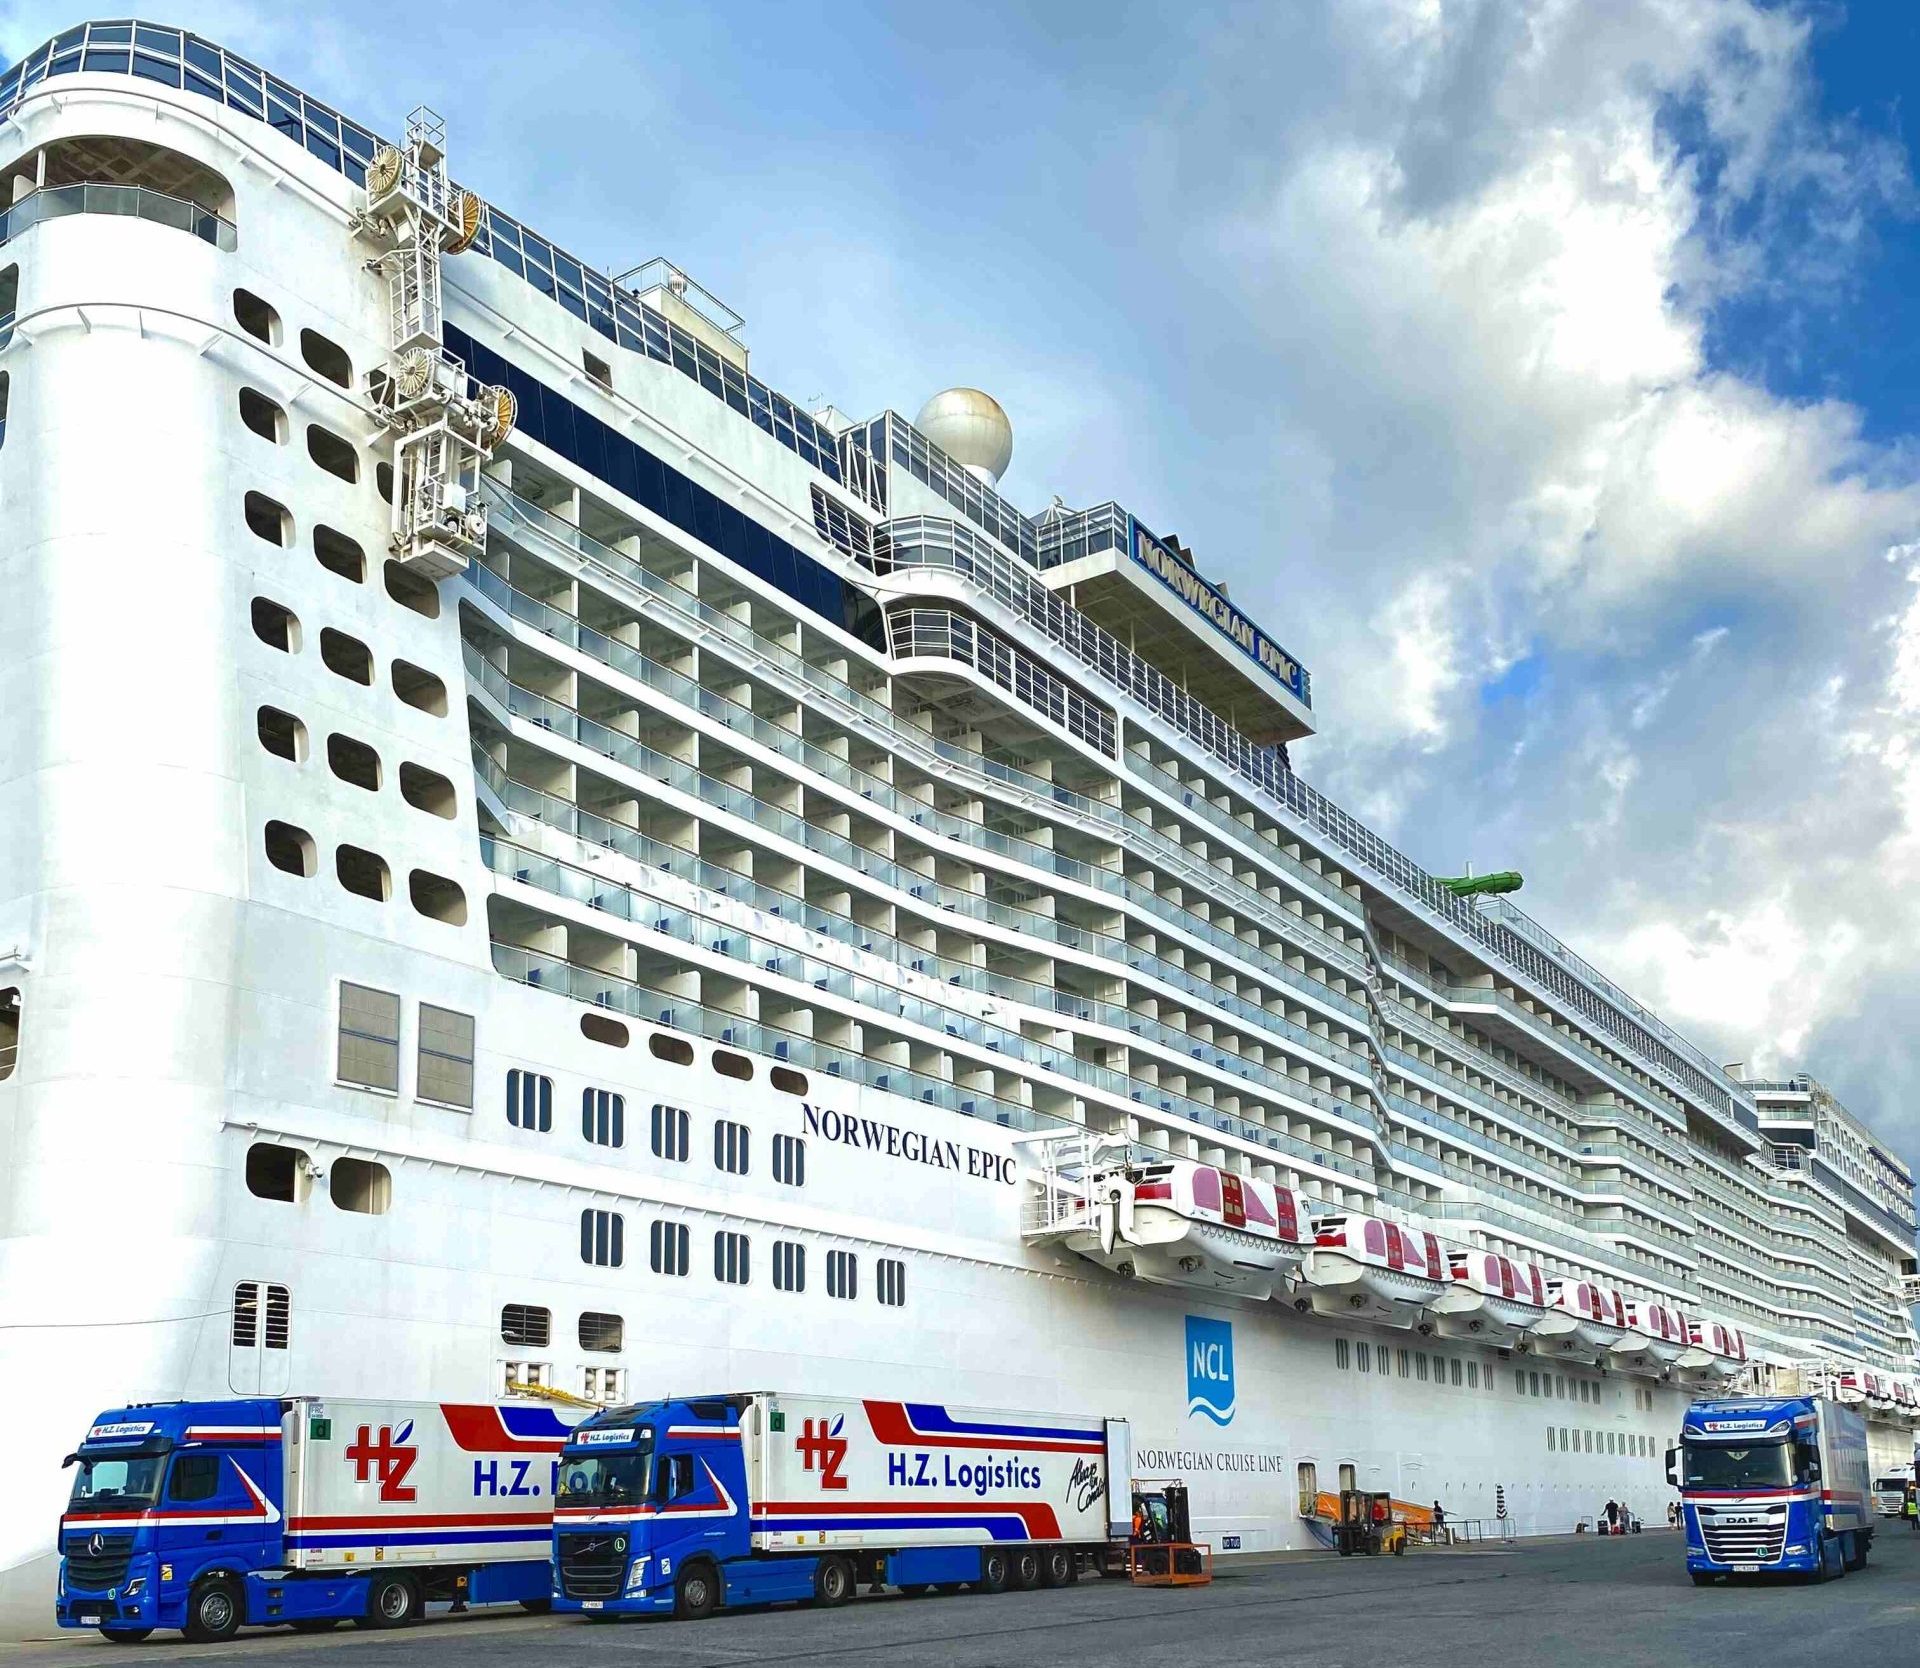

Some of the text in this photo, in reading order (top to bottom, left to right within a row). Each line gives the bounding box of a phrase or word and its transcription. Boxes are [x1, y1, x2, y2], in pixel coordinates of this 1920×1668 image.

[1137, 530, 1298, 689] NORWEGIAN EPIC
[802, 1102, 1017, 1186] NORWEGIAN EPIC
[1193, 1341, 1229, 1381] NCL
[115, 1424, 145, 1433] Logistics
[316, 1419, 326, 1437] d
[590, 1433, 601, 1441] H.Z.
[602, 1433, 629, 1442] Logistics
[344, 1424, 419, 1503] HZ
[795, 1416, 849, 1491] HZ
[1137, 1450, 1282, 1473] NORWEGIAN CRUISE LINE
[473, 1460, 540, 1496] H.Z.
[888, 1452, 1041, 1496] H.Z. Logistics
